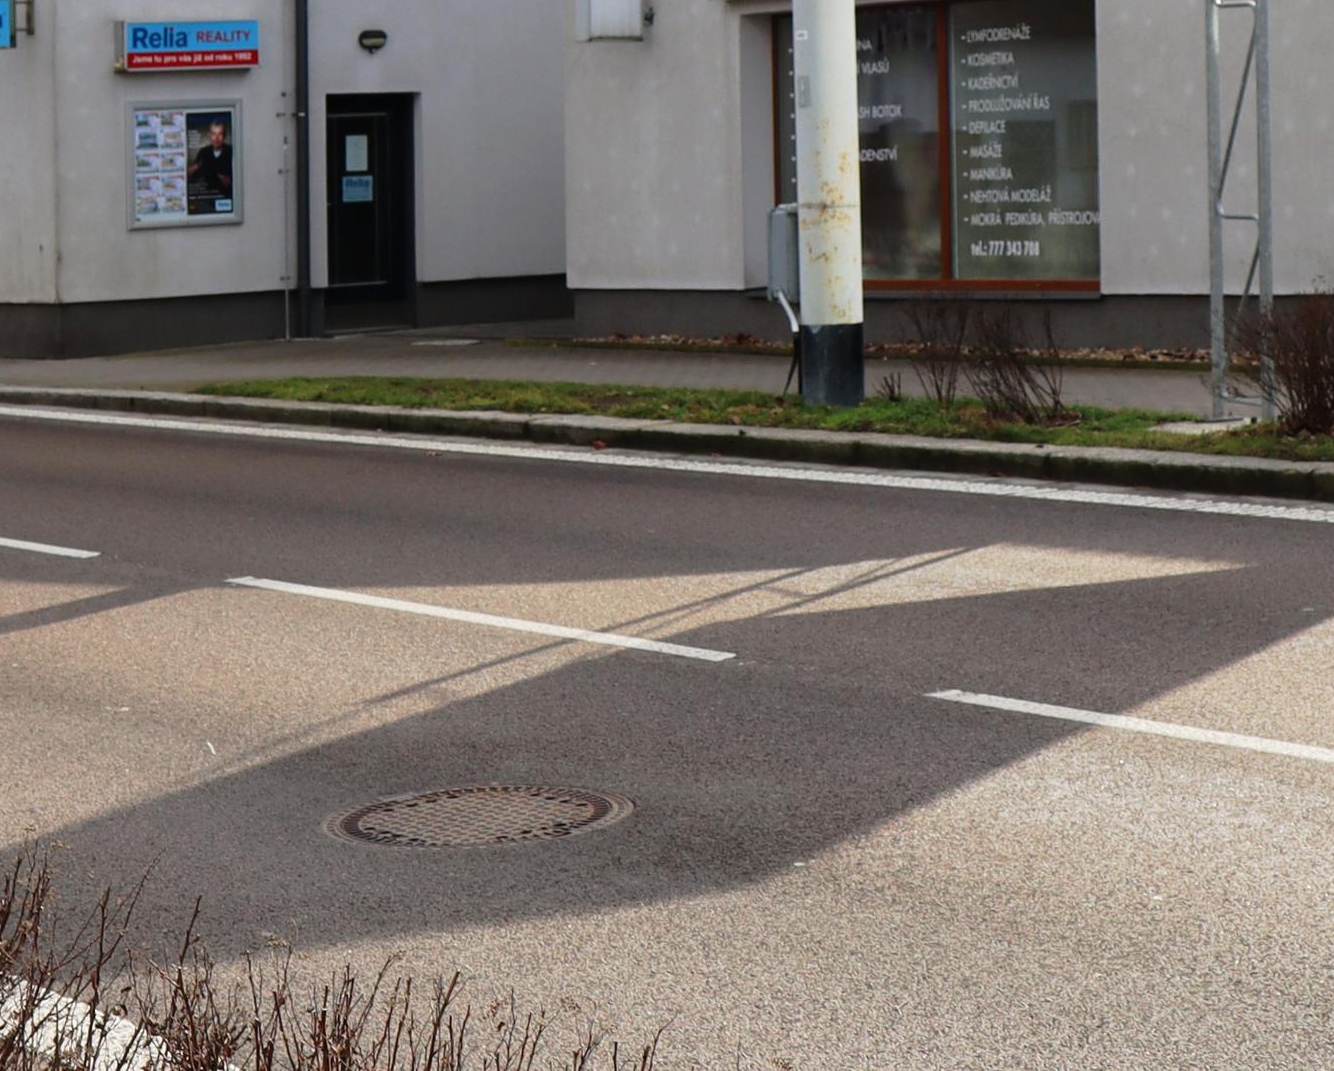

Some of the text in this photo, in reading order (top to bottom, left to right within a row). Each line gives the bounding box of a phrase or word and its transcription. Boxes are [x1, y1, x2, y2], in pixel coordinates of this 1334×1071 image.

[132, 26, 252, 49] Relia REALITY
[967, 22, 1031, 43] LYMFODRENÁŽE
[164, 55, 177, 64] pro
[204, 52, 214, 61] od
[215, 53, 233, 61] roku
[968, 51, 1015, 66] KOSMETIKA
[968, 72, 1019, 90] KADEŘNICTVÍ
[969, 93, 1050, 112] PRODLUŽOVÁNÍ ŘAS
[872, 105, 902, 118] BOTOX
[969, 120, 1006, 134] DEPILACE
[970, 141, 1003, 158] MASÁŽE
[970, 164, 1013, 180] MANIKÚRA
[970, 185, 1051, 203] NEHTOVÁ MODELÁŽ
[971, 209, 1002, 226] MOKRÁ
[989, 240, 1005, 256] 777
